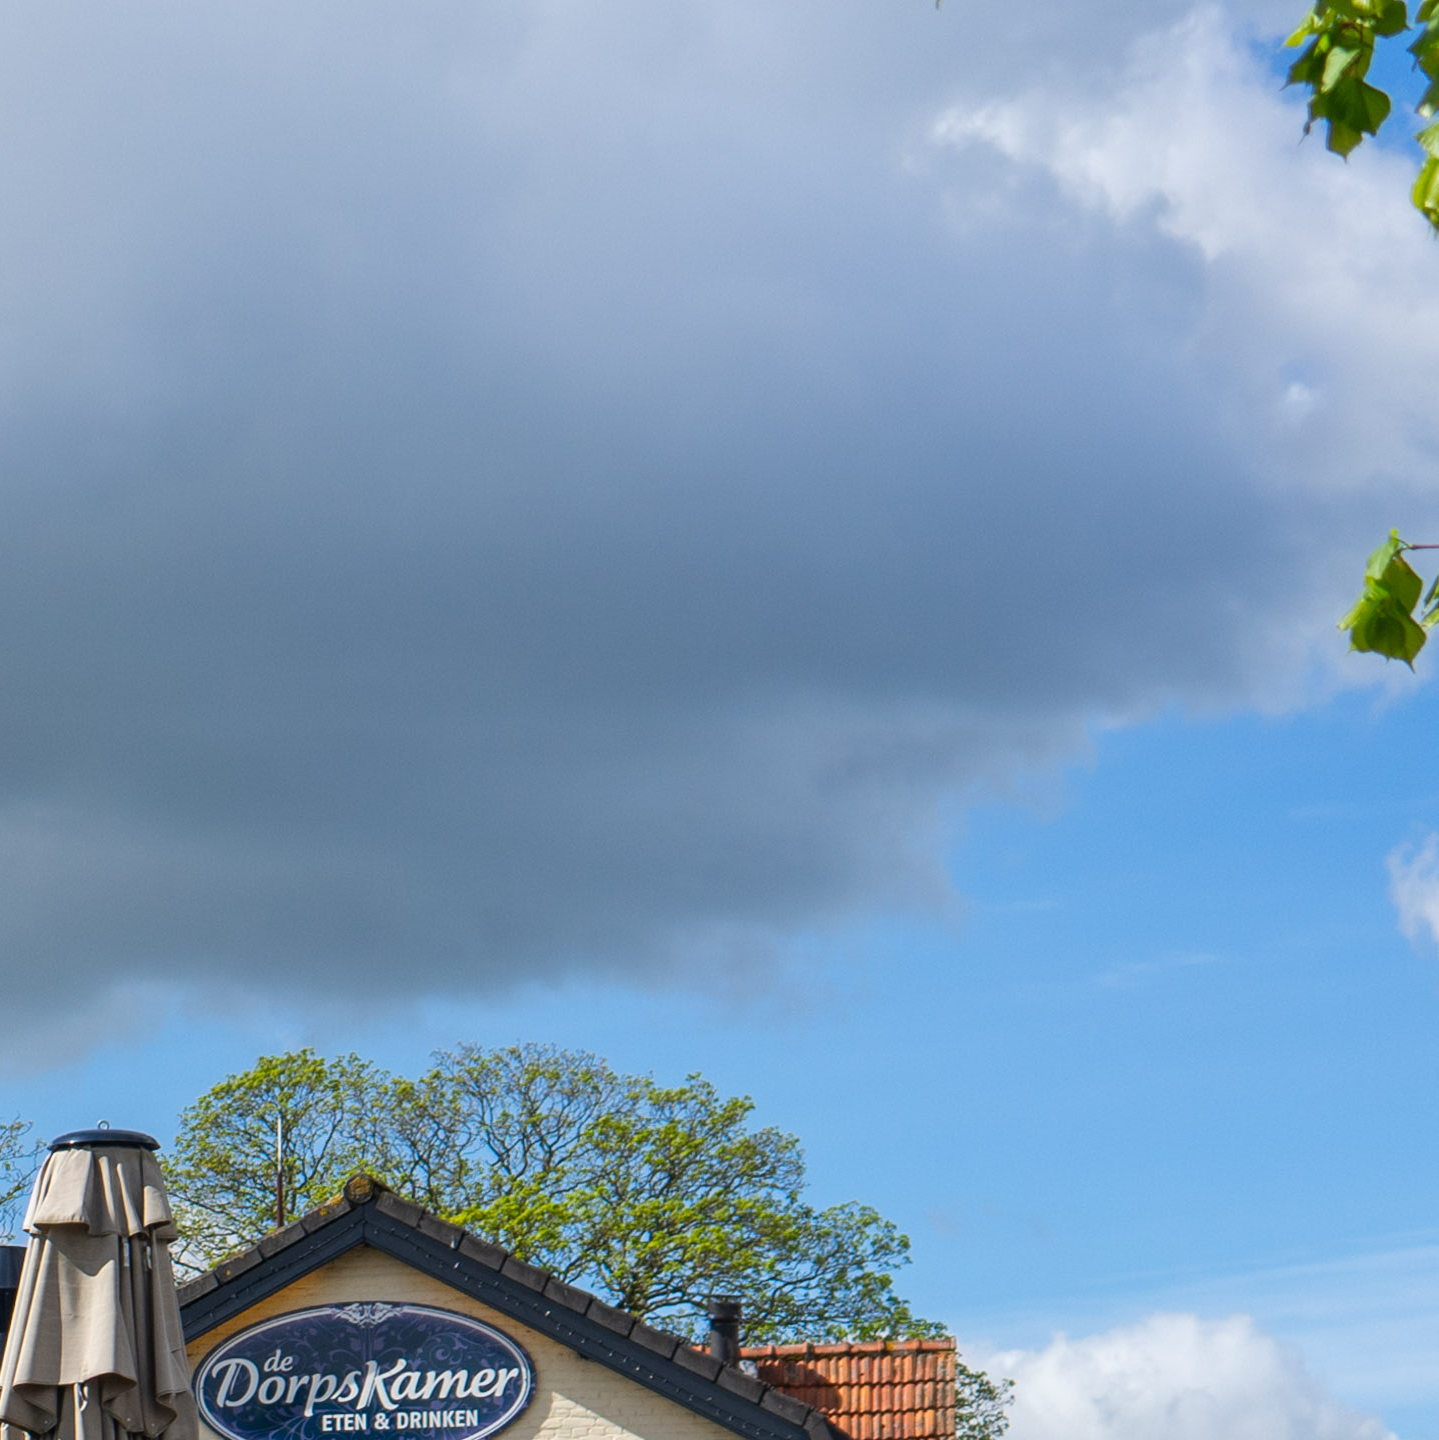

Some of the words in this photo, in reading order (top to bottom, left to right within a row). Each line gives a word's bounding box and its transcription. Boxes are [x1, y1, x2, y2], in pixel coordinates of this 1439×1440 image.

[264, 1350, 293, 1373] de
[211, 1357, 519, 1417] DorpsKamer
[322, 1413, 367, 1432] ETEN
[374, 1413, 390, 1430] &
[396, 1410, 478, 1430] DRINKEN
